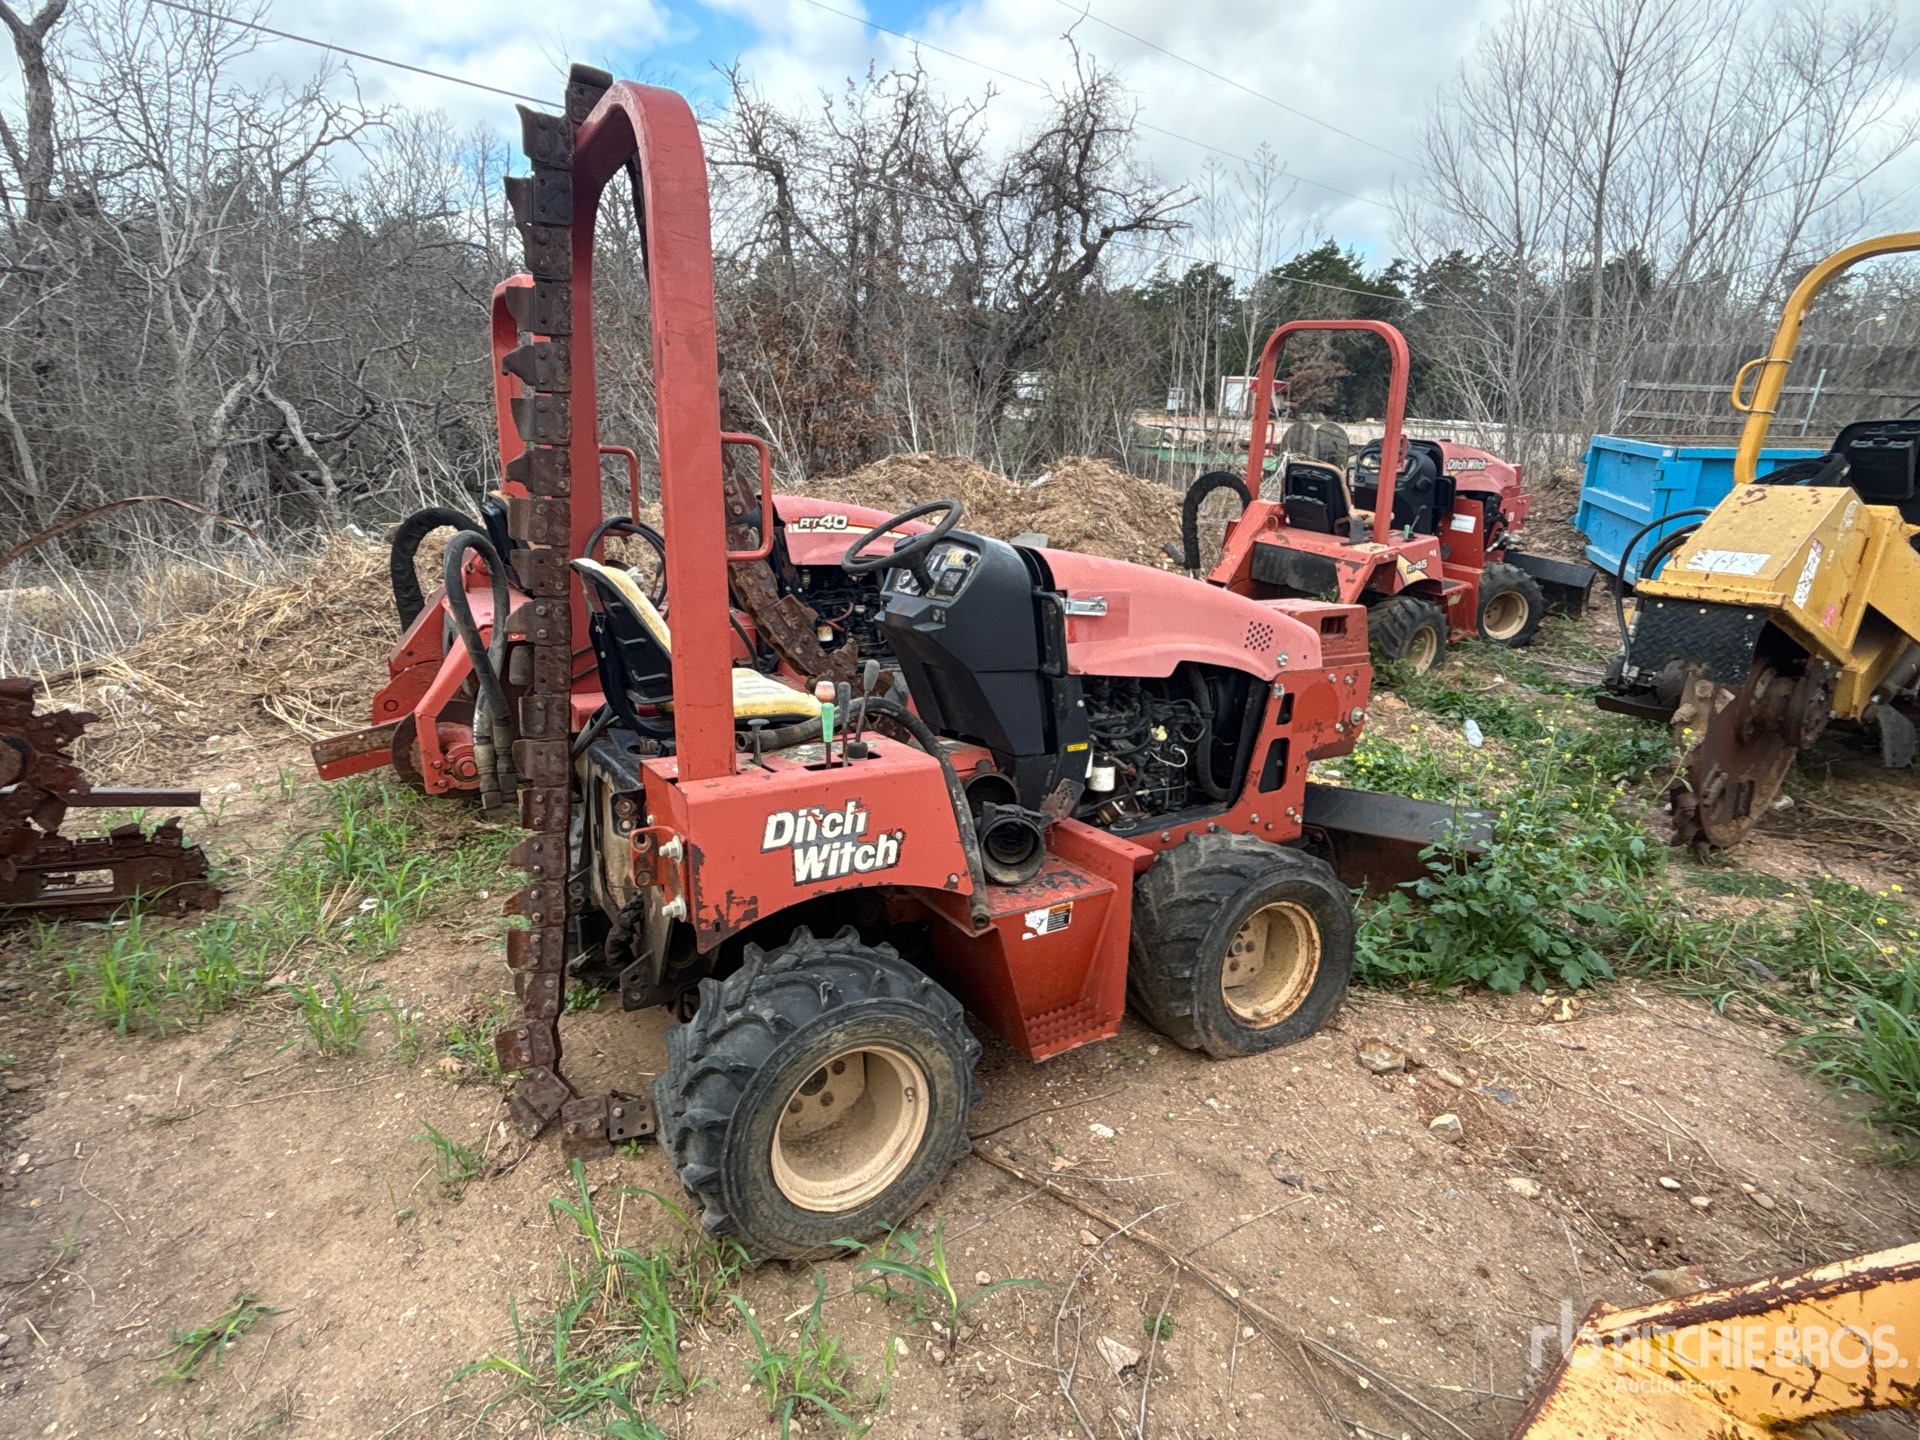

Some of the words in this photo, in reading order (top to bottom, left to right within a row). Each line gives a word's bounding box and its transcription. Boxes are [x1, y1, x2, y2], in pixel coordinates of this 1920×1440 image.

[1447, 458, 1466, 470] Ditch
[1467, 458, 1487, 470] Witch
[799, 514, 848, 530] RT40
[1406, 558, 1428, 573] RT45
[762, 800, 868, 850] Ditch
[793, 833, 899, 883] Witch
